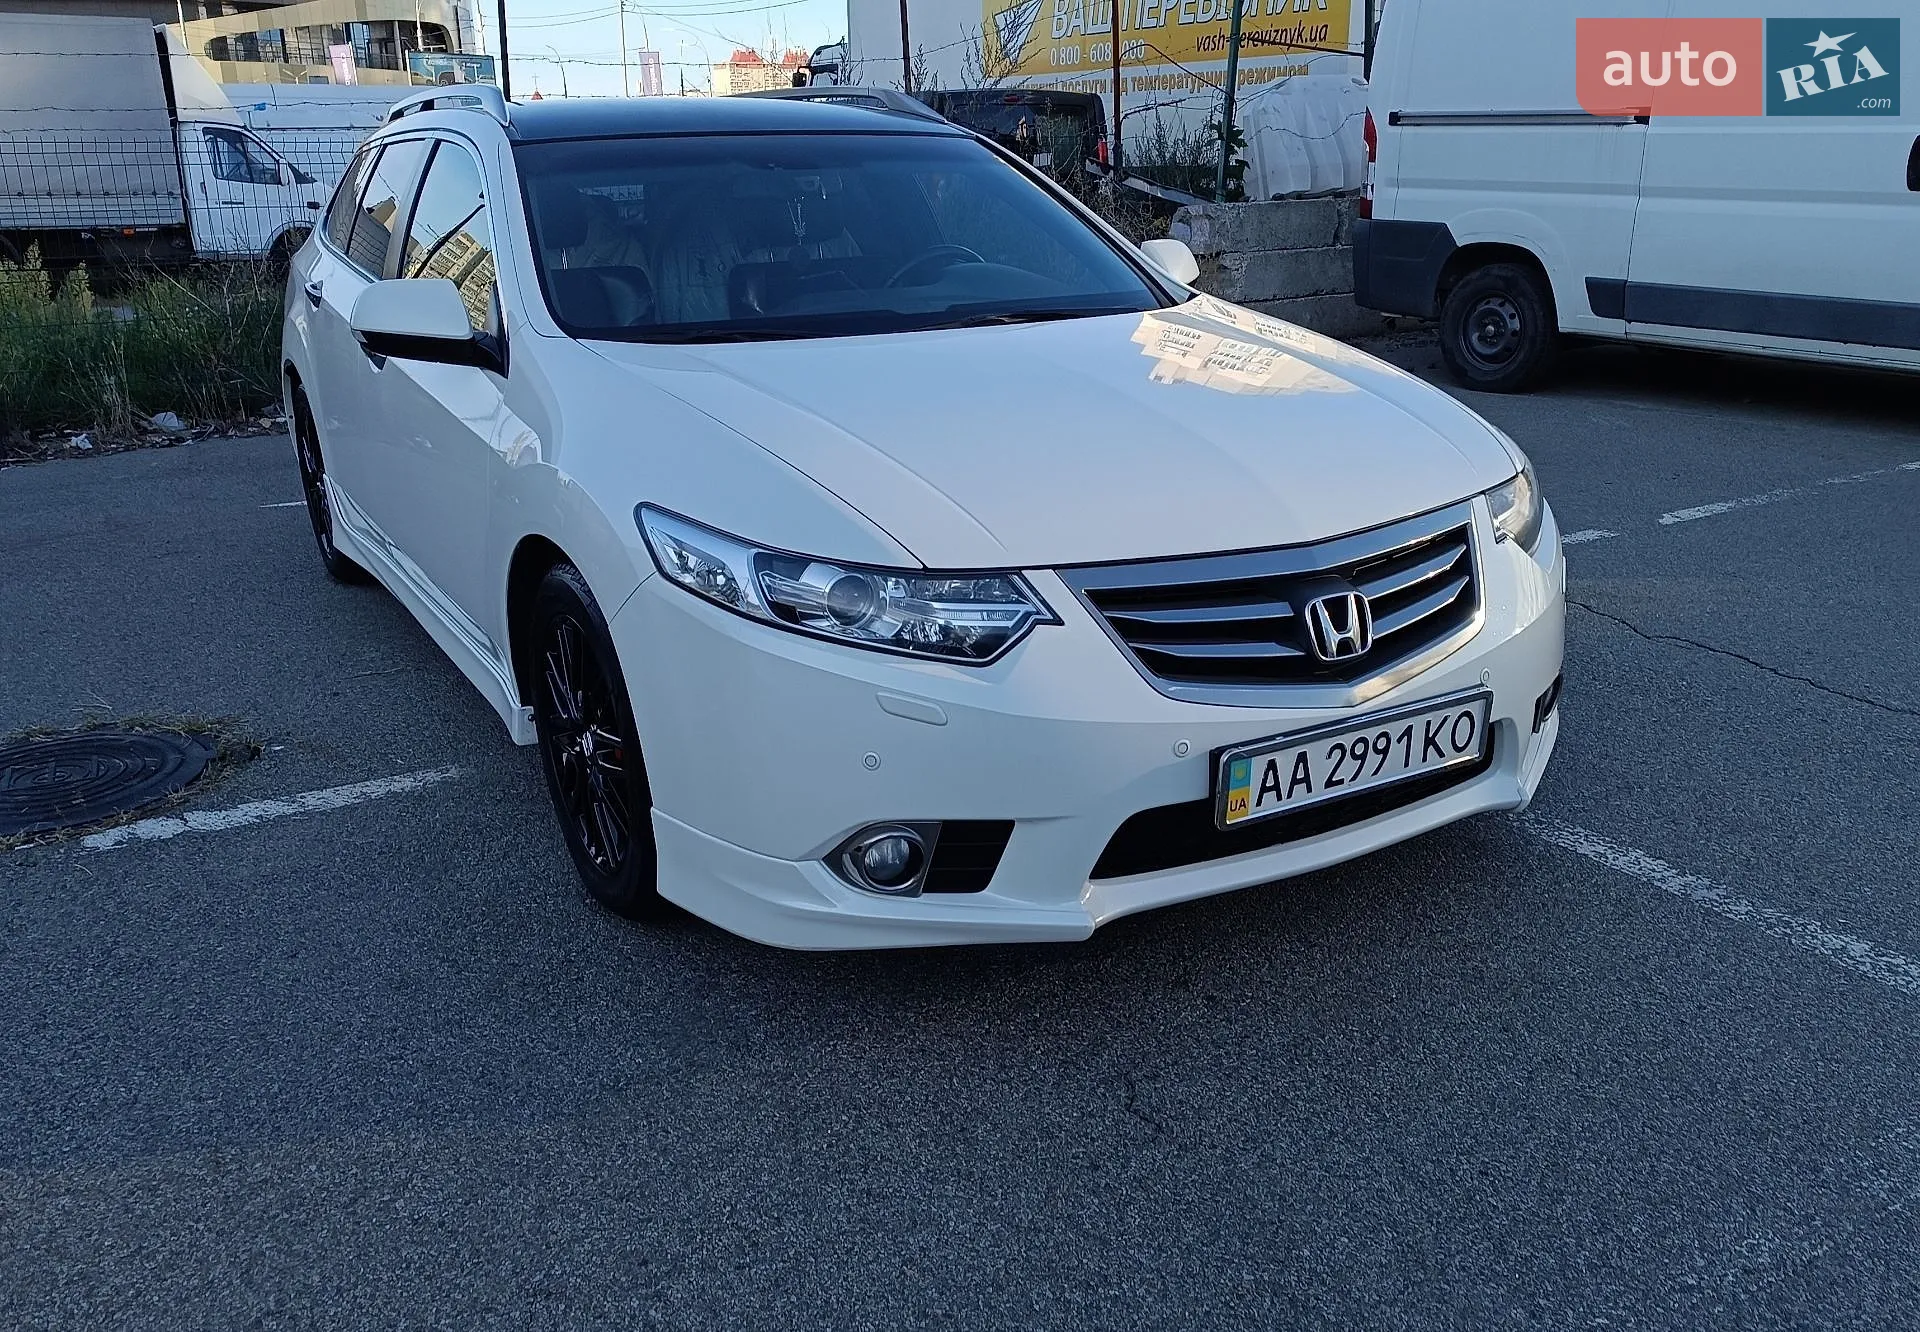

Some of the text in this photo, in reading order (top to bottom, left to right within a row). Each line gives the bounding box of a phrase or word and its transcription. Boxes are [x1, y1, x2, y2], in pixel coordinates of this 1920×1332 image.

[1051, 0, 1328, 39] ВАШ ПЕРЕВІ
[1196, 20, 1329, 52] vash-ereviznyk.ua
[1059, 45, 1080, 65] 800
[1089, 42, 1112, 63] 608
[1131, 71, 1229, 95] температурни
[1255, 709, 1476, 808] AA 2991 KO
[1229, 798, 1247, 812] UA
